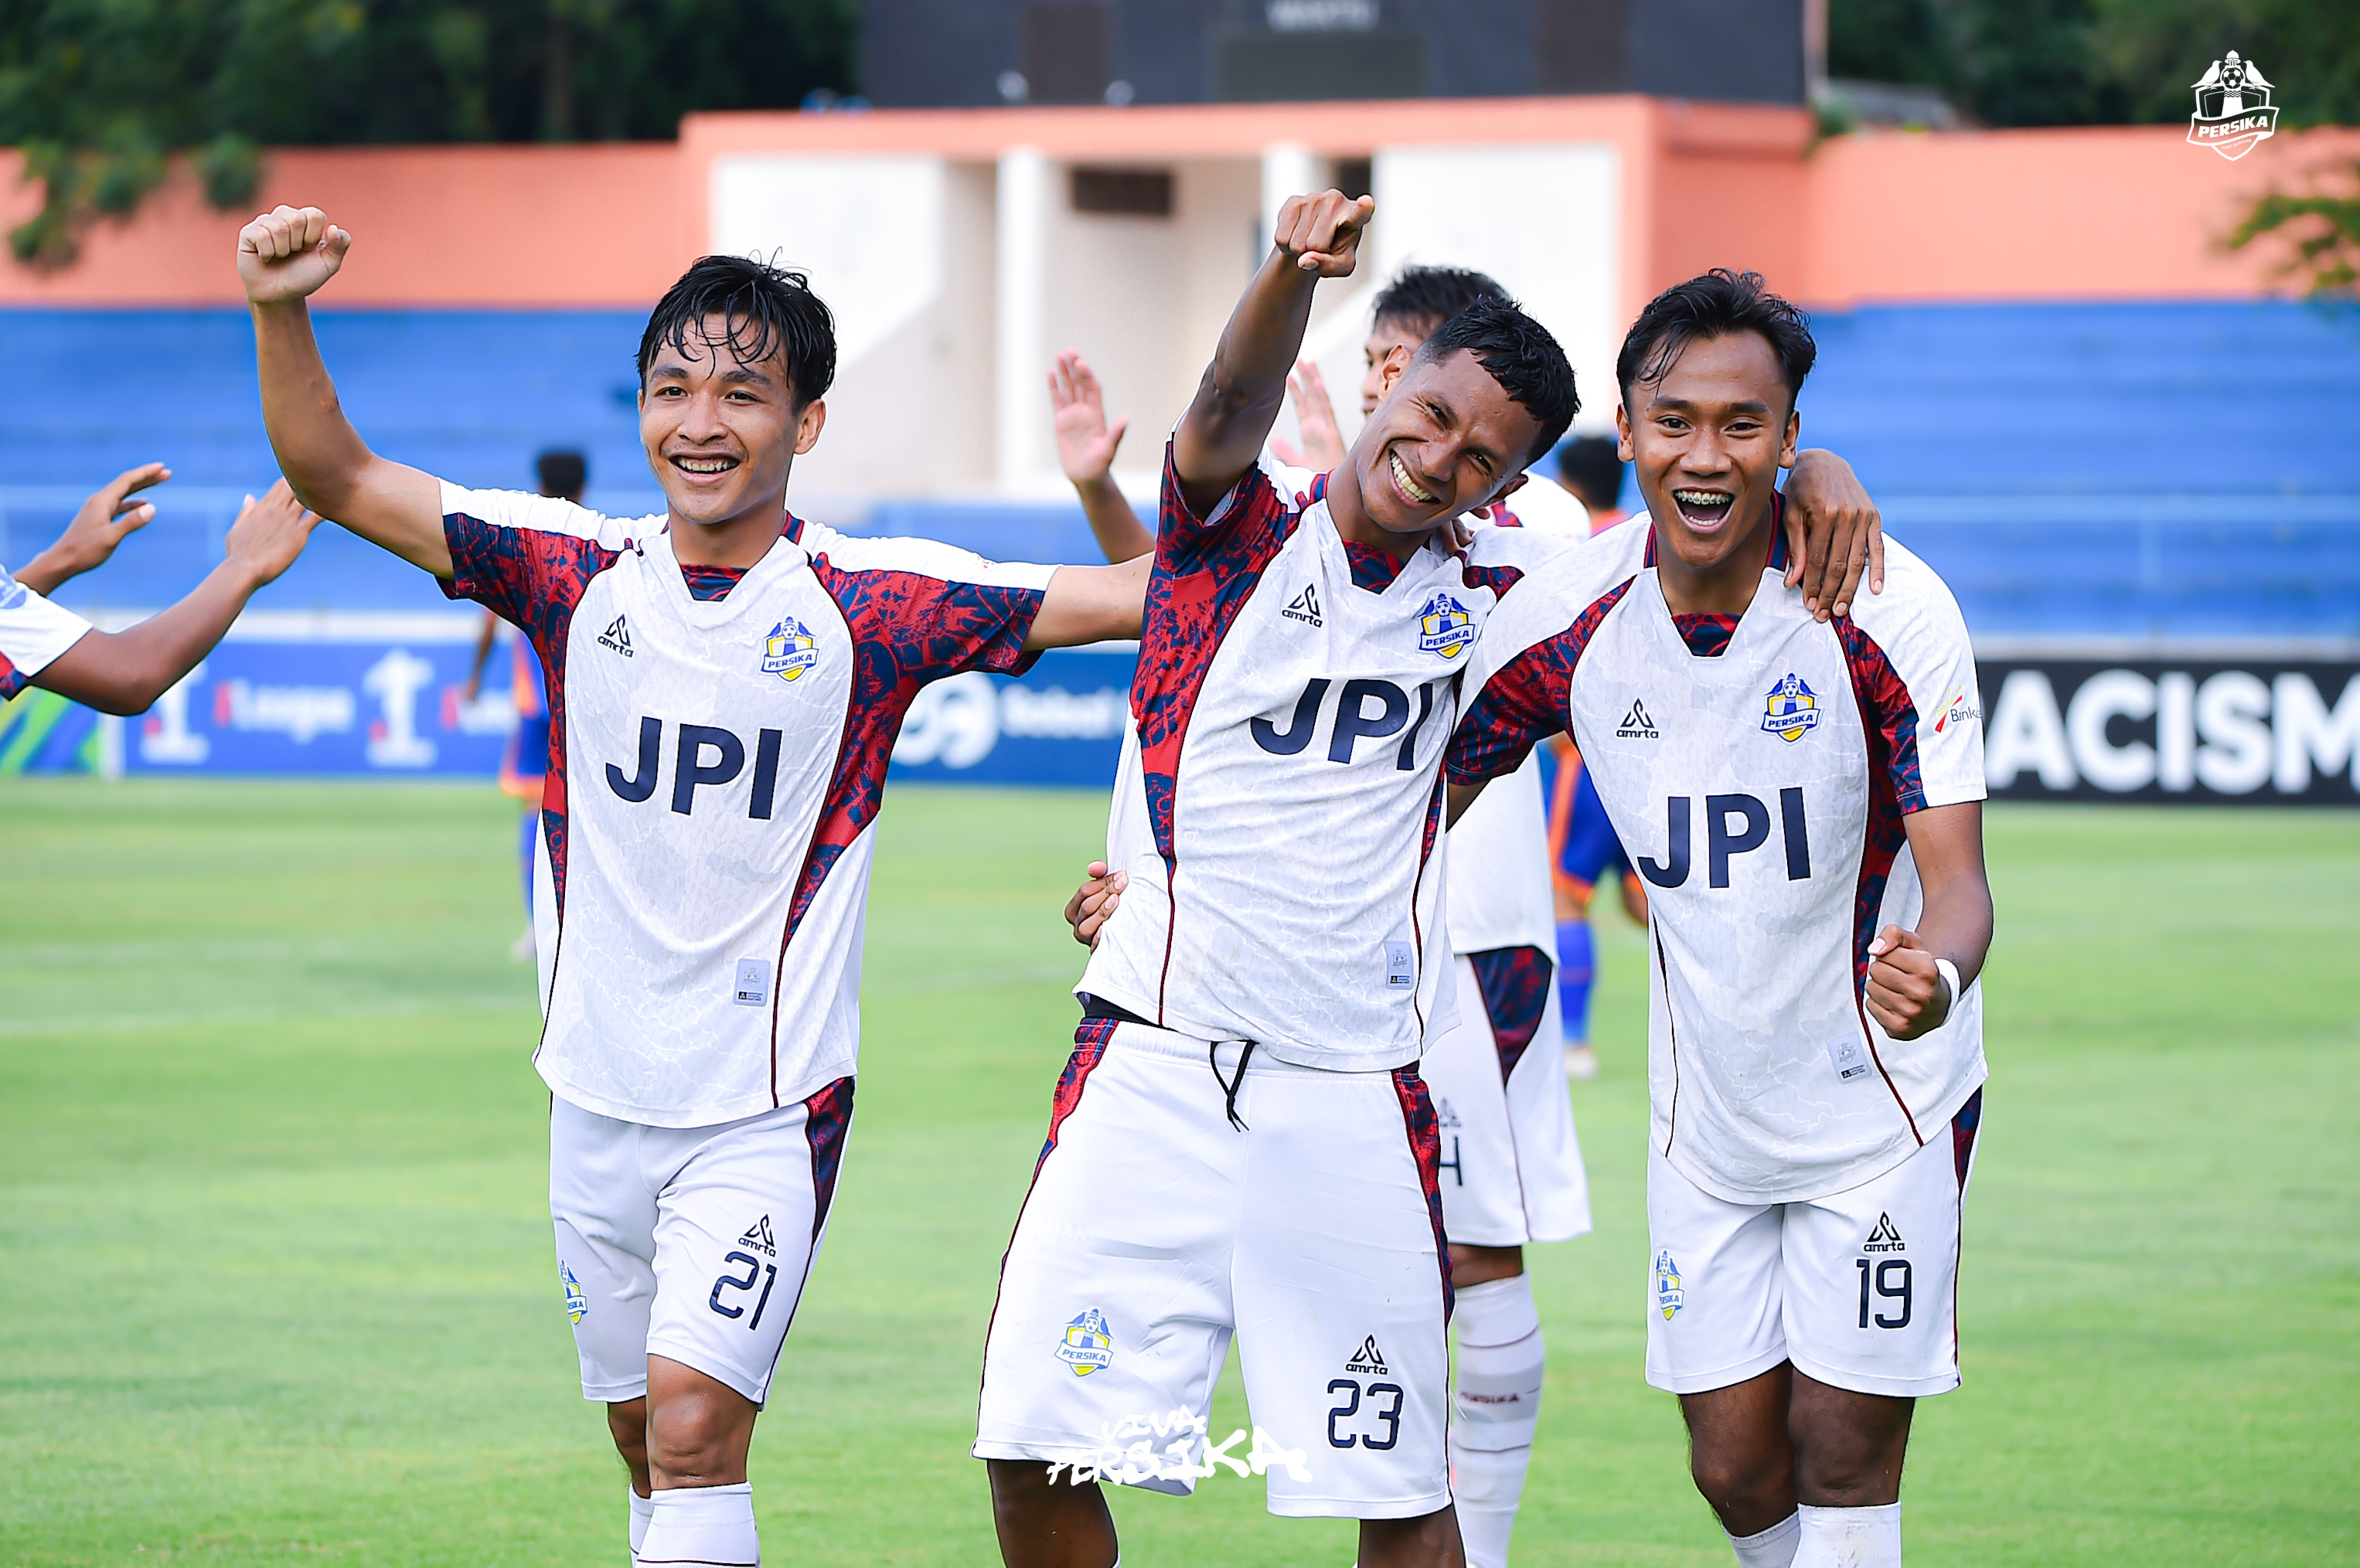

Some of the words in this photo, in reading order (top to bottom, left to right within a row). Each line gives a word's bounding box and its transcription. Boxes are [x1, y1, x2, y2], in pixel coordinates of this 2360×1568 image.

[1281, 608, 1323, 628] amrta
[598, 634, 634, 658] amrta
[1425, 629, 1470, 647] PERSIKA
[768, 652, 813, 670] PERSIKA
[1249, 678, 1433, 771] JPI
[1768, 713, 1814, 728] PERSIKA
[1982, 668, 2360, 794] ACISM
[1616, 728, 1659, 740] amrta
[605, 716, 784, 820] JPI
[1637, 786, 1812, 889] JPI
[738, 1236, 777, 1258] amrta
[1863, 1241, 1905, 1253] amrta
[709, 1250, 778, 1331] 21
[1856, 1259, 1912, 1329] 19
[1061, 1348, 1107, 1364] PERSIKA
[1345, 1363, 1388, 1376] amrta
[1326, 1379, 1405, 1451] 23
